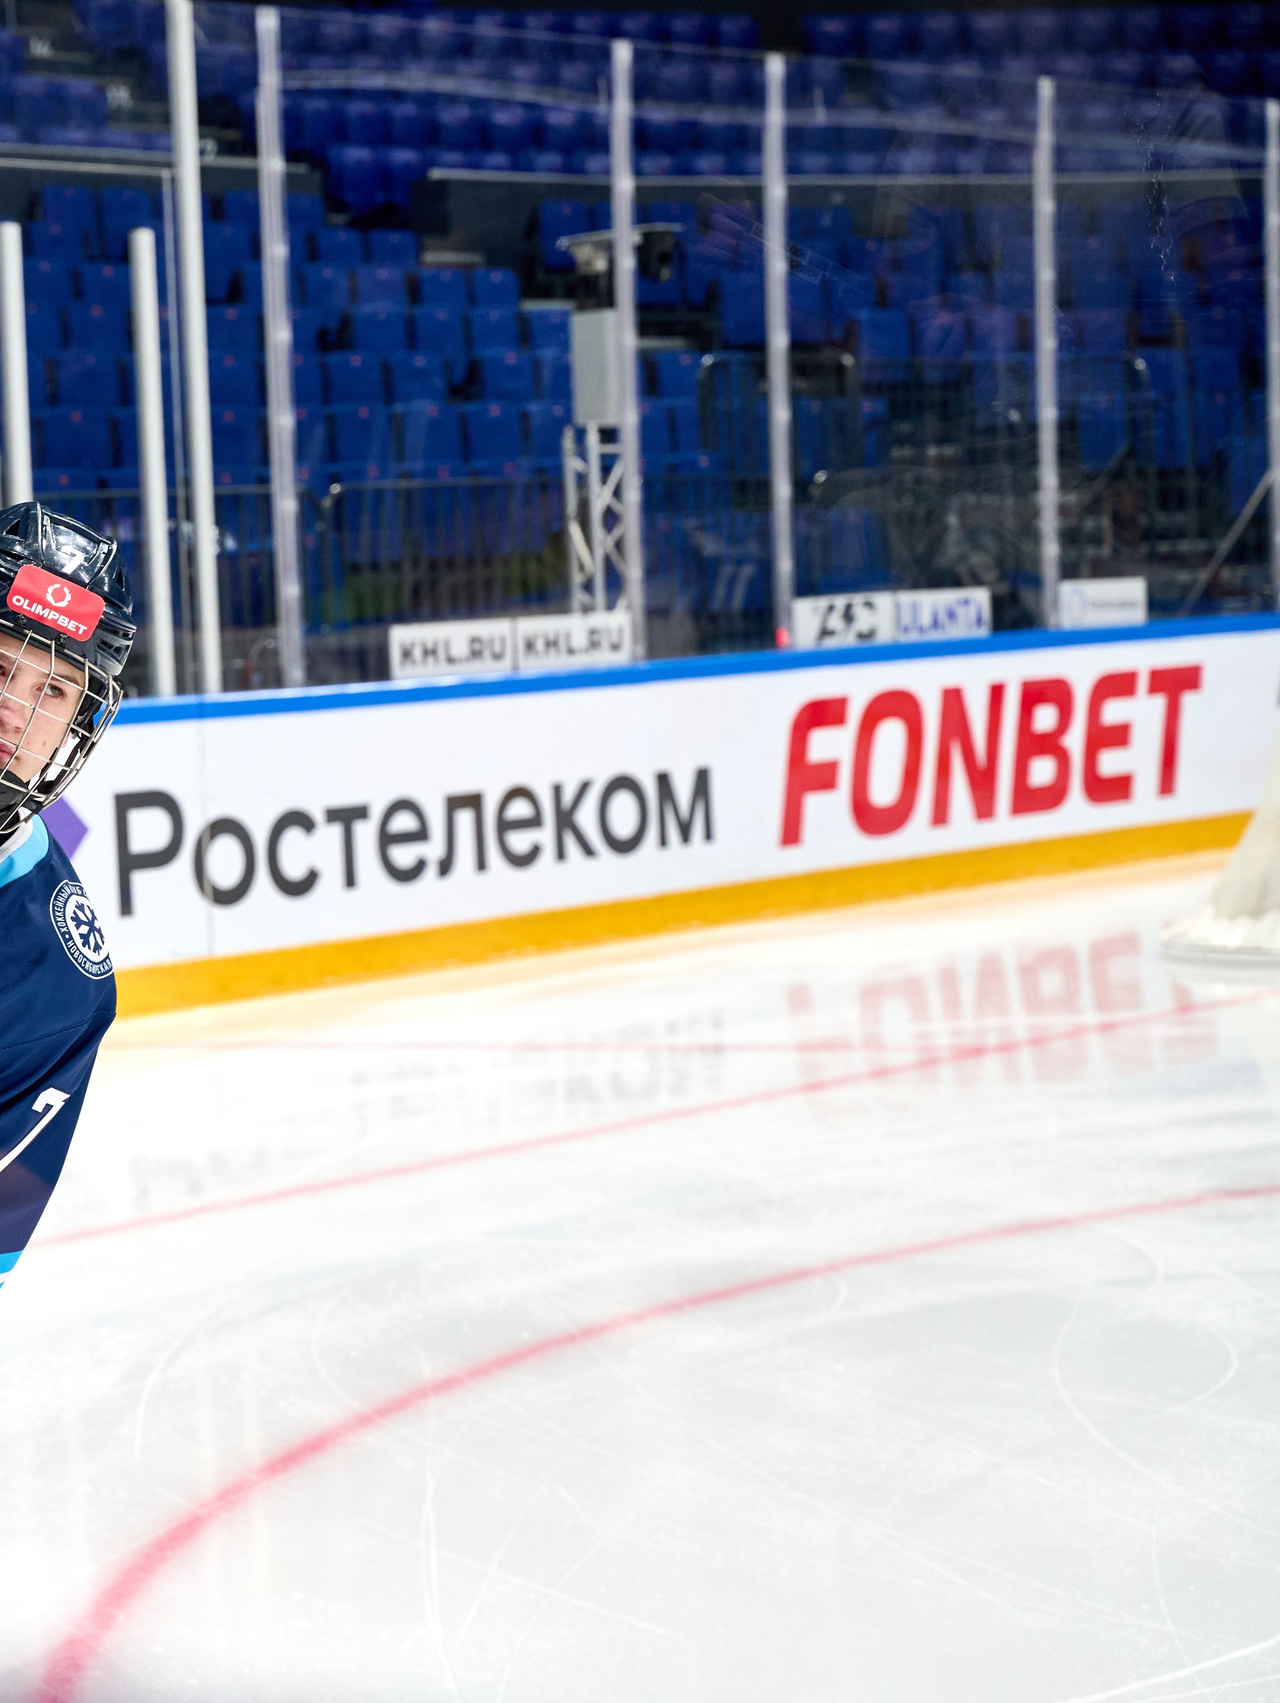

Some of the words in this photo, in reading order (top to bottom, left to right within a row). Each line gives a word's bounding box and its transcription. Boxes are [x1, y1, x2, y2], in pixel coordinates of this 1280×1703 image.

[60, 545, 85, 575] 7
[12, 595, 88, 636] OLIMPBET
[399, 635, 507, 668] KHL.RU
[522, 623, 625, 656] KHL.RU
[779, 663, 1203, 849] FONBET
[114, 765, 715, 918] Ростелеком
[53, 884, 72, 933] ХОККЕЙНЫЙ
